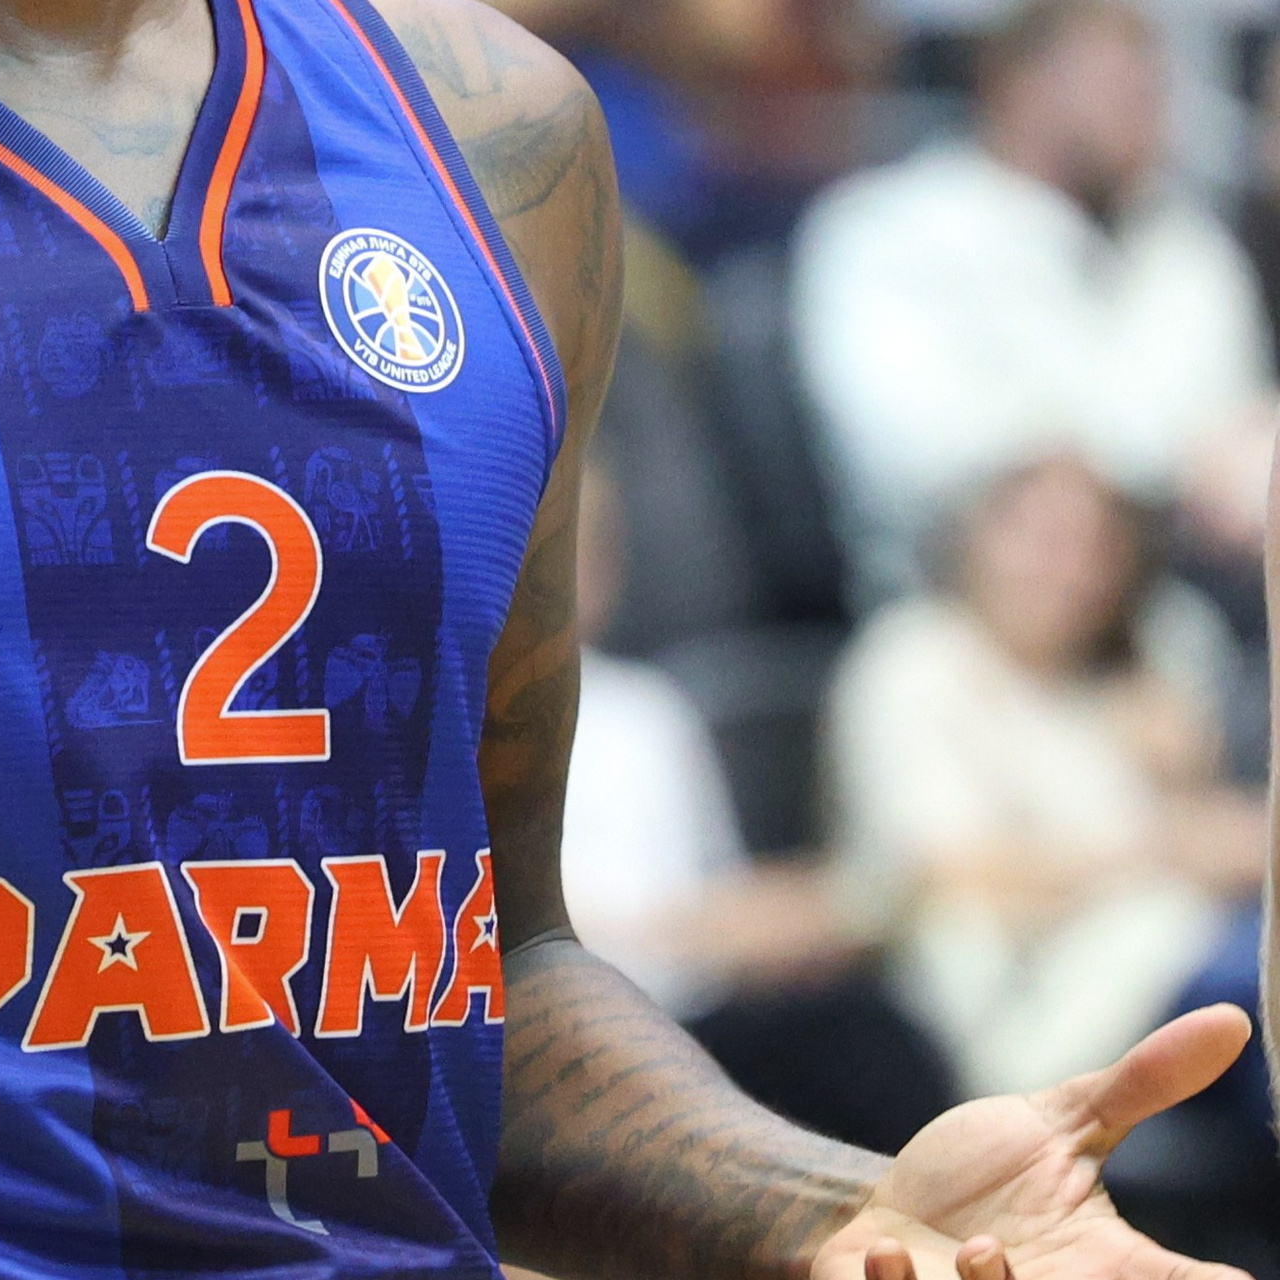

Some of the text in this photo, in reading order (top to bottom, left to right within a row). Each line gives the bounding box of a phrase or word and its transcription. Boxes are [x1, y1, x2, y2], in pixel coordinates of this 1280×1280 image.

[329, 236, 433, 281] ЕДИНАЯ ЛИГА ВТБ
[353, 339, 457, 383] VTB UNITED LEAGUE
[146, 469, 331, 766] 2
